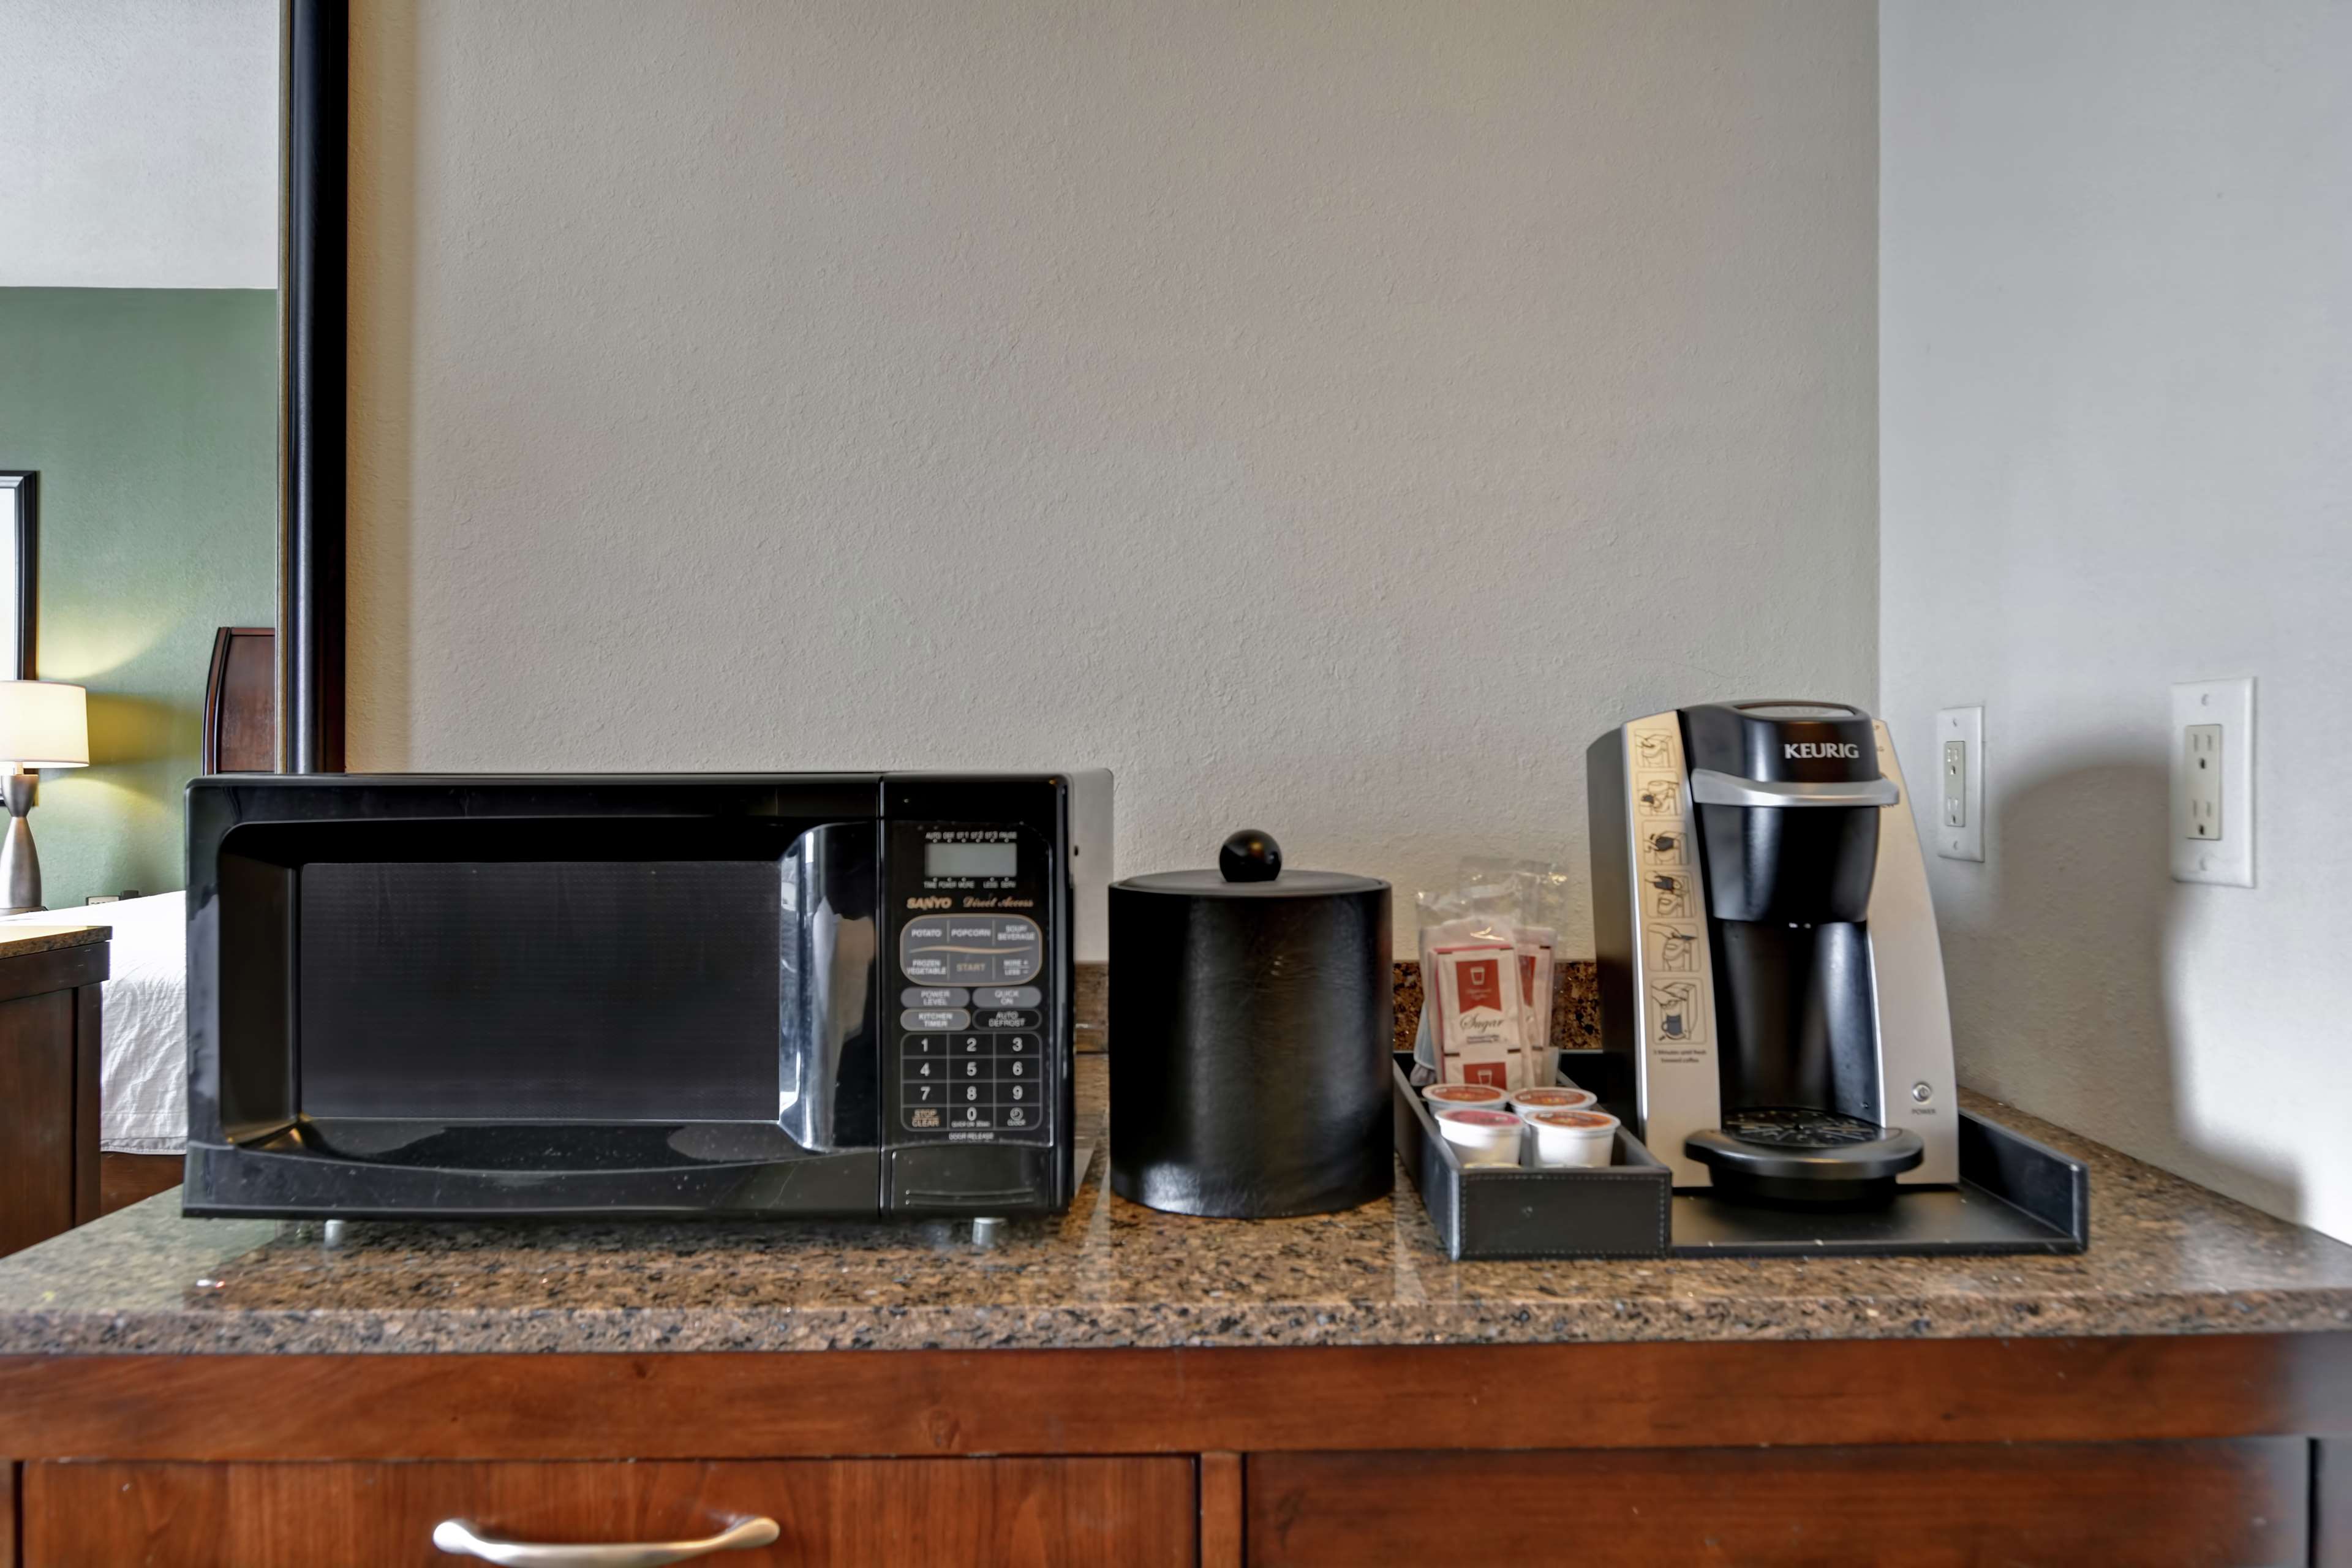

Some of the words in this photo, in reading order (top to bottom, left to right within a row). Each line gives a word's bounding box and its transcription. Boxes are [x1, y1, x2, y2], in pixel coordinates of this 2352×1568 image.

[1784, 742, 1860, 759] KEURIG
[907, 895, 952, 910] SANYO
[911, 929, 943, 938] POTATO
[951, 929, 991, 937] POPCORN
[997, 932, 1035, 941] BEVERAGE
[907, 967, 946, 975] VEGETABLE
[956, 963, 986, 972] START
[921, 990, 951, 998] POWER
[994, 990, 1020, 998] QUICK
[918, 1012, 954, 1020] KITCHEN
[995, 1011, 1019, 1019] AUTO
[988, 1019, 1027, 1028] DEFROST
[1460, 1013, 1505, 1033] Sugar
[921, 1038, 929, 1052] 1
[967, 1038, 977, 1052] 2
[1012, 1037, 1023, 1052] 3
[920, 1062, 930, 1077] 4
[967, 1061, 977, 1076] 5
[1012, 1061, 1023, 1076] 6
[921, 1086, 931, 1101] 7
[967, 1086, 977, 1101] 8
[1012, 1085, 1023, 1100] 9
[914, 1109, 937, 1118] STOP
[967, 1107, 977, 1121] 0
[911, 1118, 940, 1127] CLEAR
